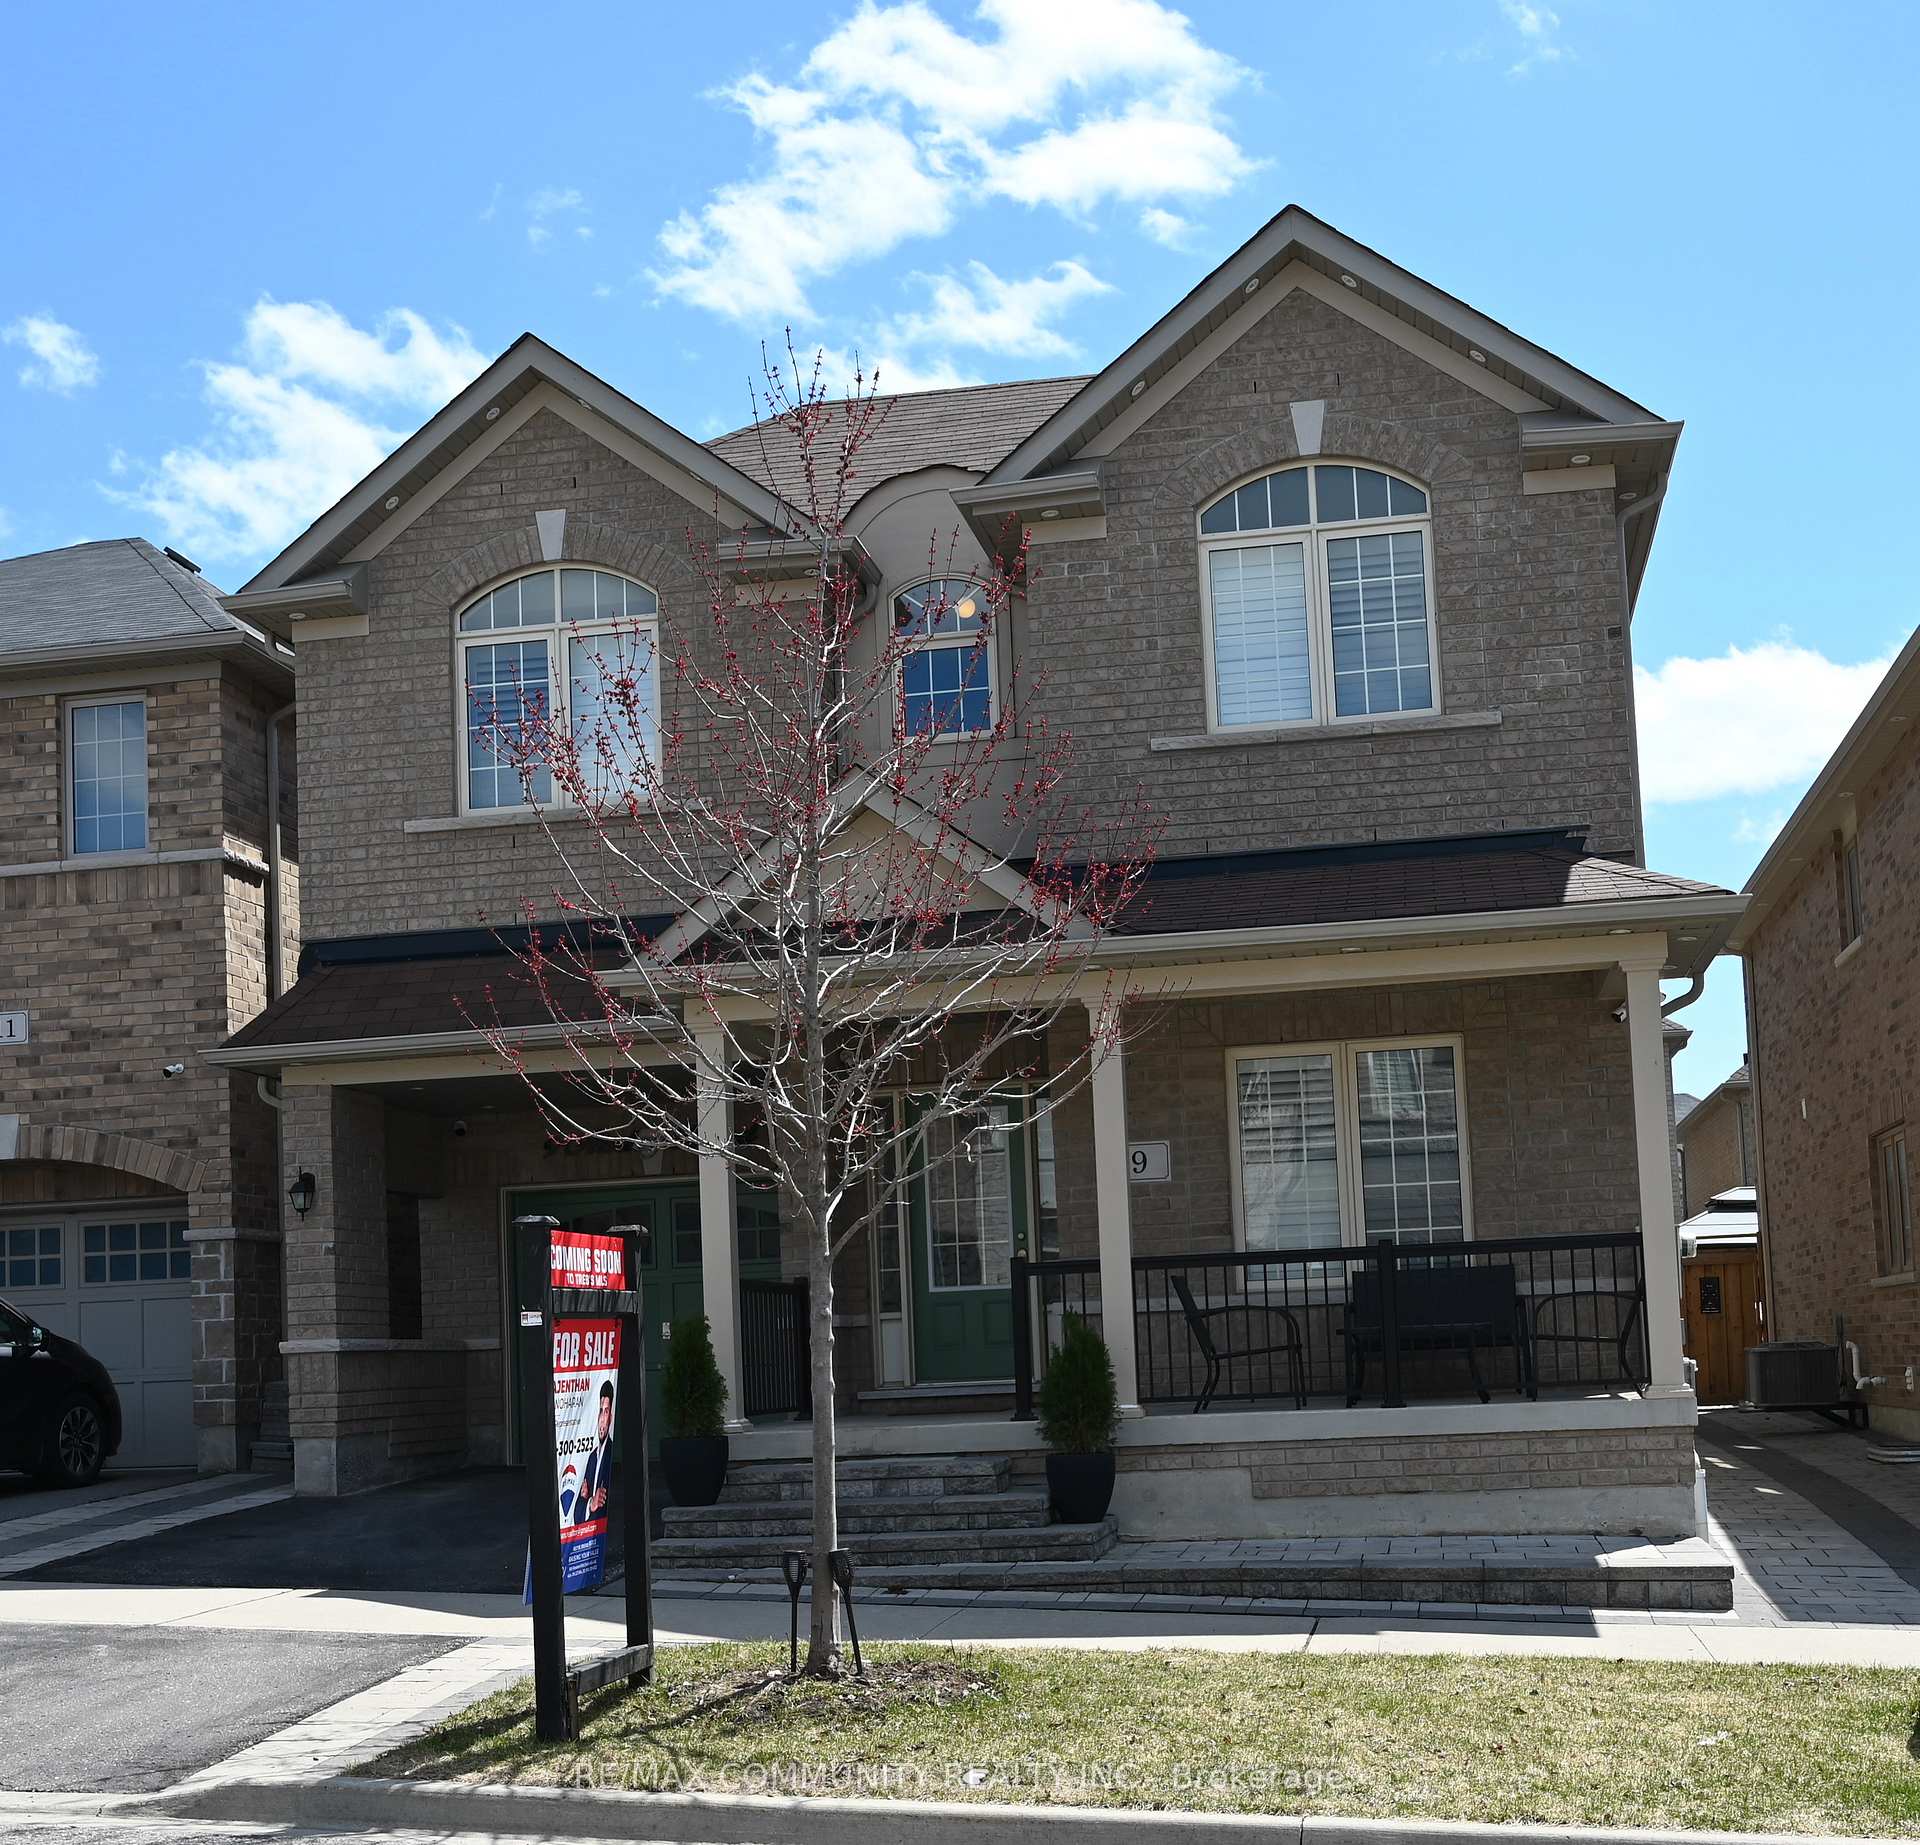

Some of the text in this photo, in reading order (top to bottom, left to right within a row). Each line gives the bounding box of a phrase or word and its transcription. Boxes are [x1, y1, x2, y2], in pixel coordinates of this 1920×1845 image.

[1132, 1150, 1147, 1174] 9
[551, 1244, 622, 1274] COMING SOON
[553, 1331, 615, 1369] FOR SALE
